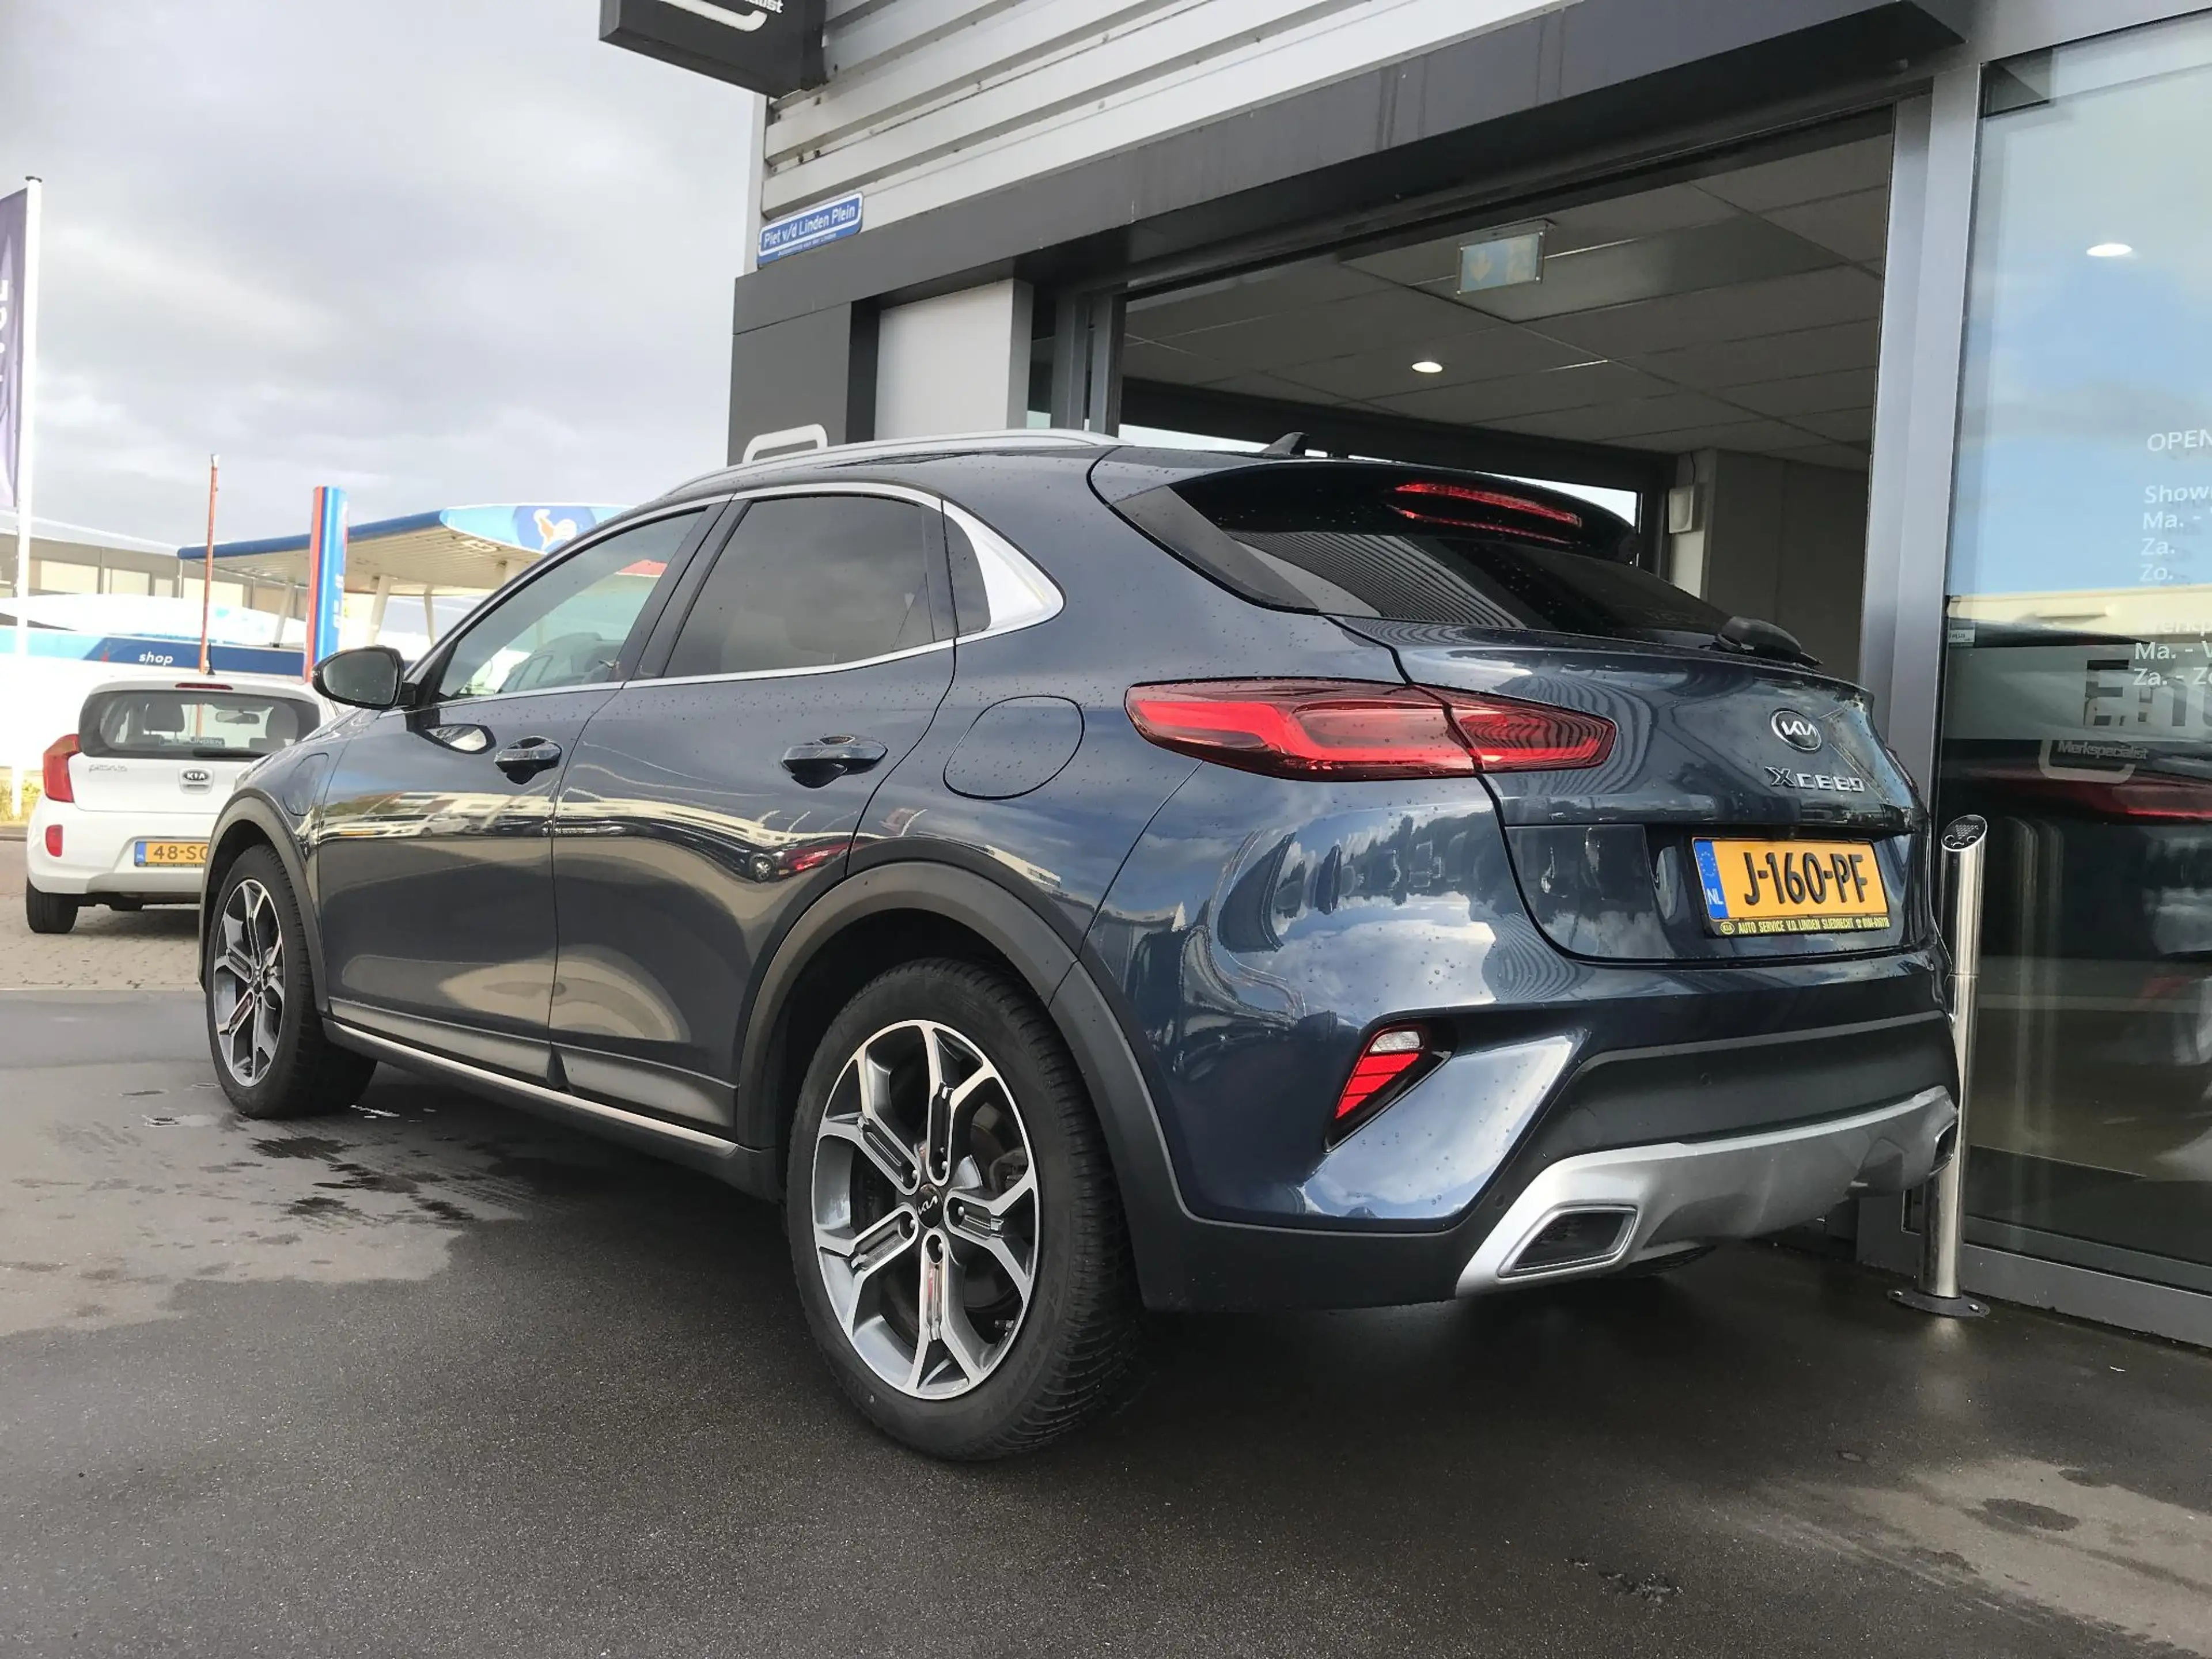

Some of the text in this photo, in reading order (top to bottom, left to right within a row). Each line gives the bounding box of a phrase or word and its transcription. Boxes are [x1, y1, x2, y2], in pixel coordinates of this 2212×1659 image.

[764, 232, 781, 248] Piet
[783, 223, 797, 241] v/d
[799, 215, 830, 236] Linden
[831, 205, 855, 224] Plein
[2143, 484, 2212, 503] Show
[2142, 511, 2184, 529] Ma.
[2141, 537, 2175, 555] Za.
[2139, 563, 2173, 581] Zo.
[138, 652, 173, 665] shop
[2135, 642, 2176, 660] Ma.
[2133, 668, 2168, 685] Za.
[187, 772, 206, 780] KIA
[1707, 852, 1868, 906] NL J-160-PF
[1738, 922, 1757, 934] AUTO
[1759, 921, 1784, 933] SERVICE
